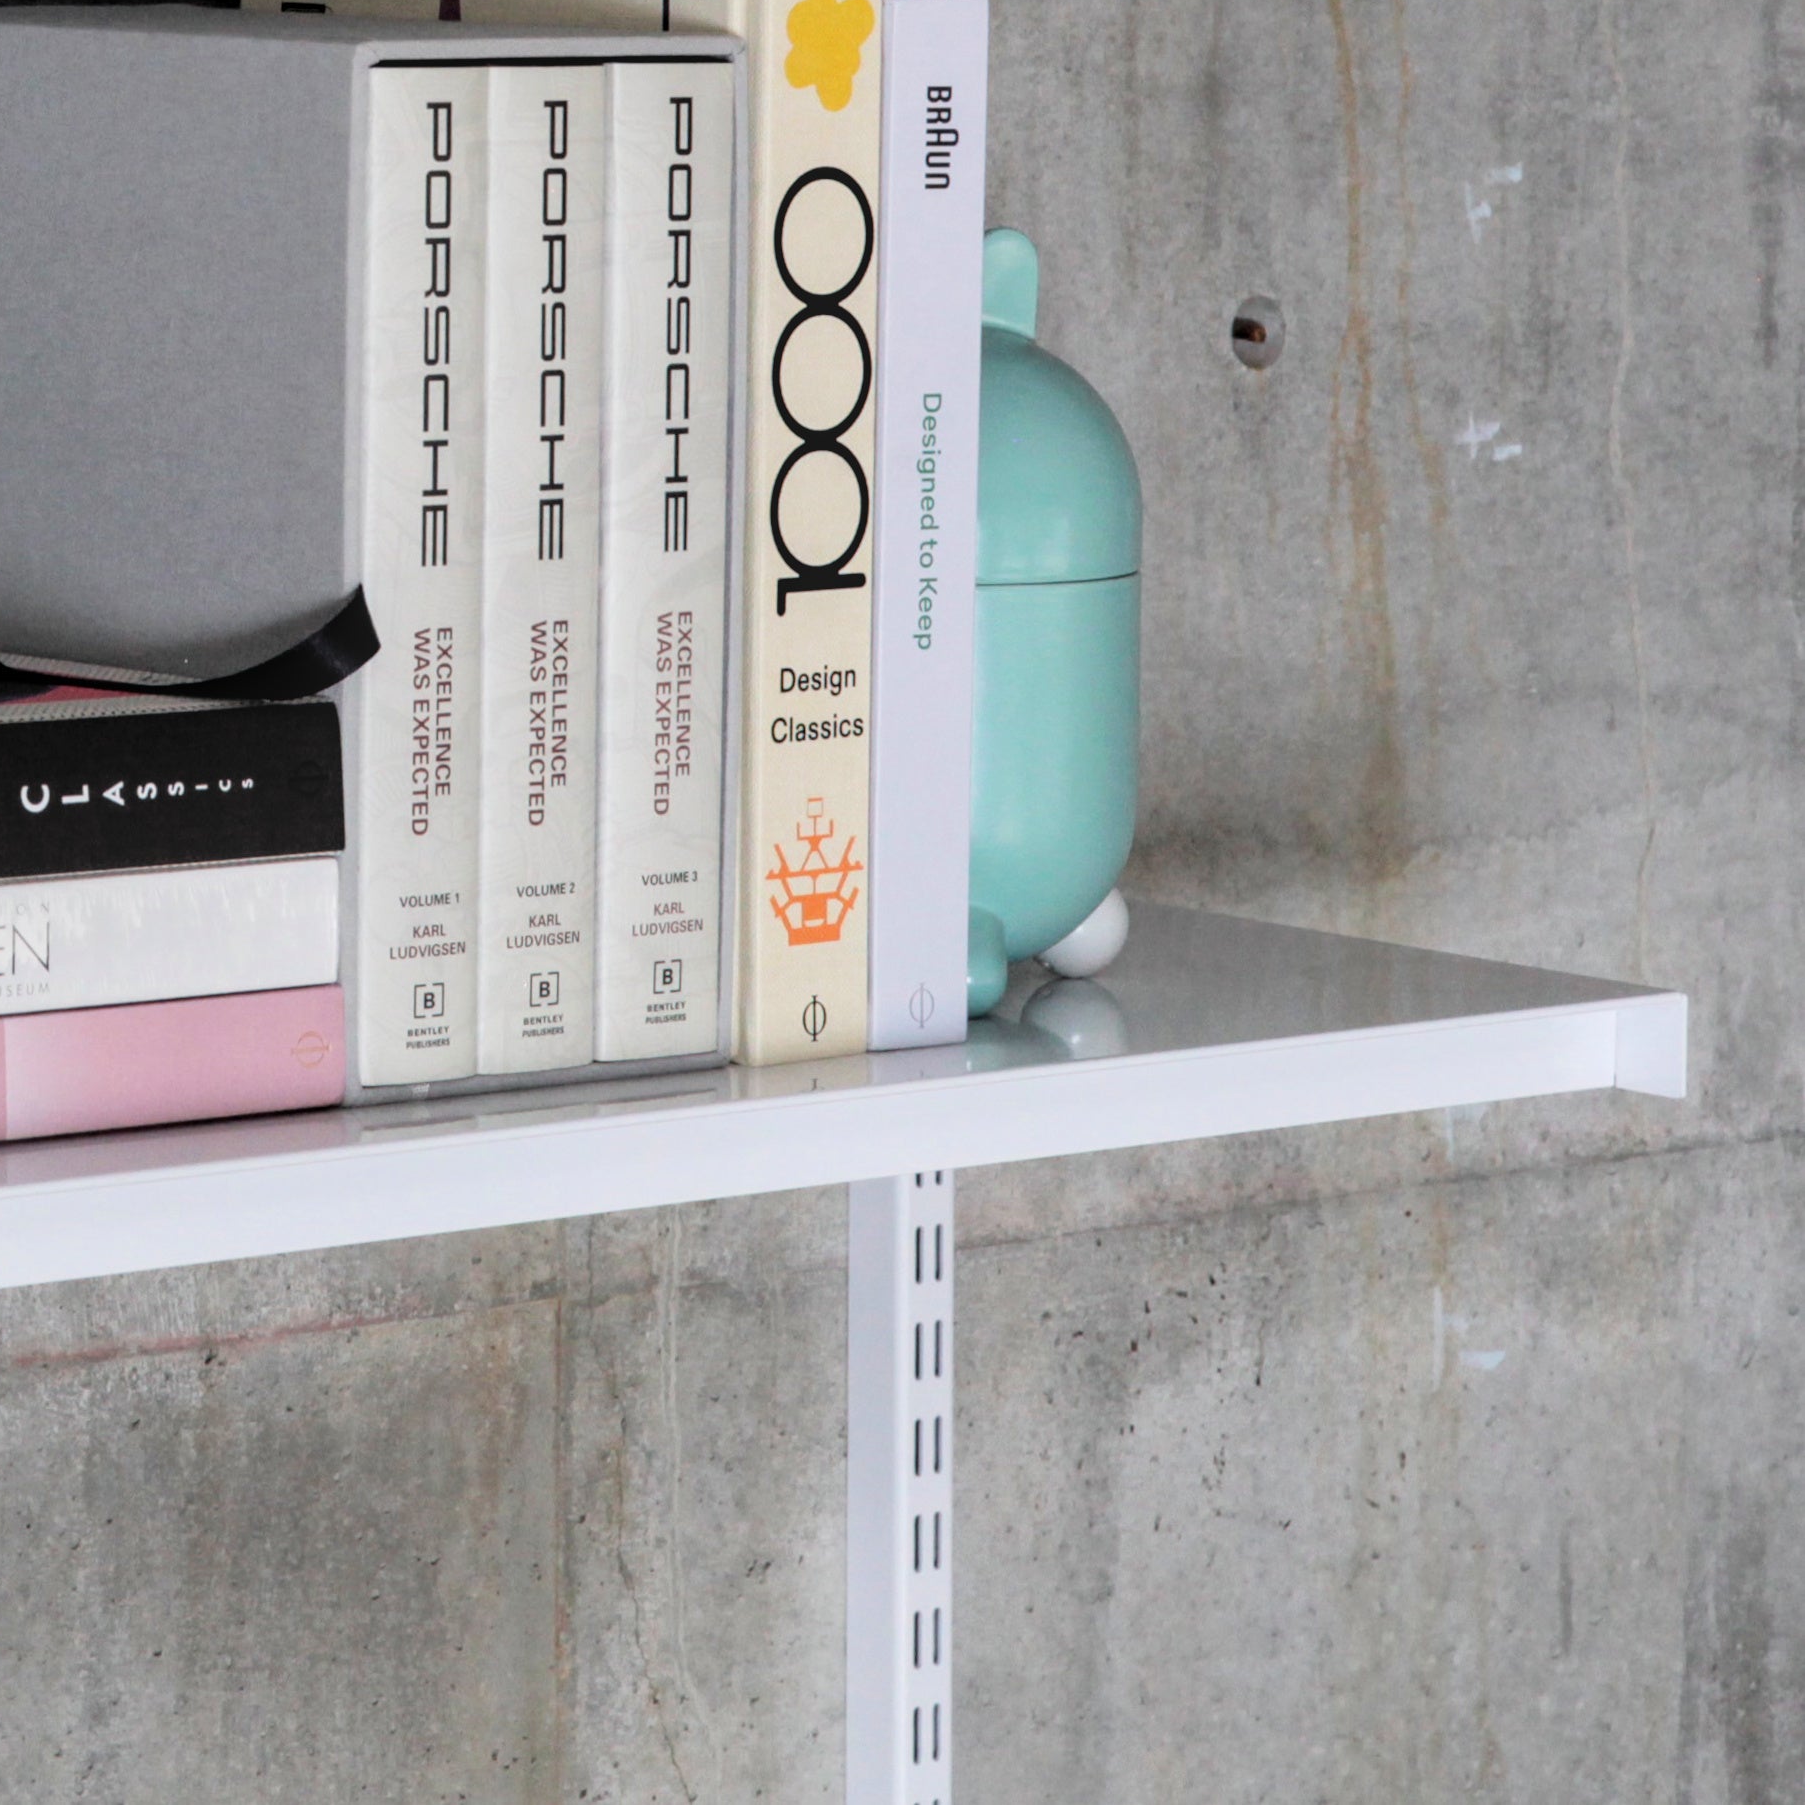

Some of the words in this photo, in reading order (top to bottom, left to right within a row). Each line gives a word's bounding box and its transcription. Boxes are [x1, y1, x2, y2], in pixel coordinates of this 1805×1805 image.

[923, 84, 960, 191] BRAUN
[421, 101, 452, 567] PORSCHE
[538, 100, 568, 561] PORSCHE
[664, 96, 694, 553] PORSCHE
[768, 166, 875, 616] 1000
[916, 392, 943, 530] Designed
[919, 537, 934, 570] to
[913, 576, 939, 651] Keep
[413, 627, 431, 690] WAS
[530, 620, 547, 682] WAS
[656, 612, 673, 672] WAS
[675, 611, 693, 776] EXCELLENCE
[779, 665, 857, 695] Design
[435, 627, 453, 796] EXCELLENCE
[551, 620, 568, 787] EXCELLENCE
[771, 716, 864, 744] Classics
[528, 691, 546, 826] EXPECTED
[654, 681, 671, 816] EXPECTED
[412, 699, 430, 836] EXPECTED
[20, 777, 254, 813] CLASSICS
[517, 884, 567, 898] VOLUME
[569, 882, 576, 894] 2
[642, 871, 689, 886] VOLUME
[691, 870, 698, 882] 3
[399, 894, 451, 908] VOLUME
[455, 893, 460, 905] 1
[653, 901, 685, 916] KARL
[412, 924, 446, 938] KARL
[528, 914, 561, 928] KARL
[632, 919, 704, 937] LUDVIGSEN
[389, 941, 466, 960] LUDVIGSEN
[506, 931, 580, 950] LUDVIGSEN
[523, 1014, 564, 1025] BENTLEY
[645, 1013, 687, 1024] PUBLISHERS
[646, 1000, 686, 1012] BENTLEY
[405, 1037, 450, 1050] PUBLISHERS
[407, 1025, 449, 1037] BENTLEY
[522, 1026, 564, 1037] PUBLISHERS
